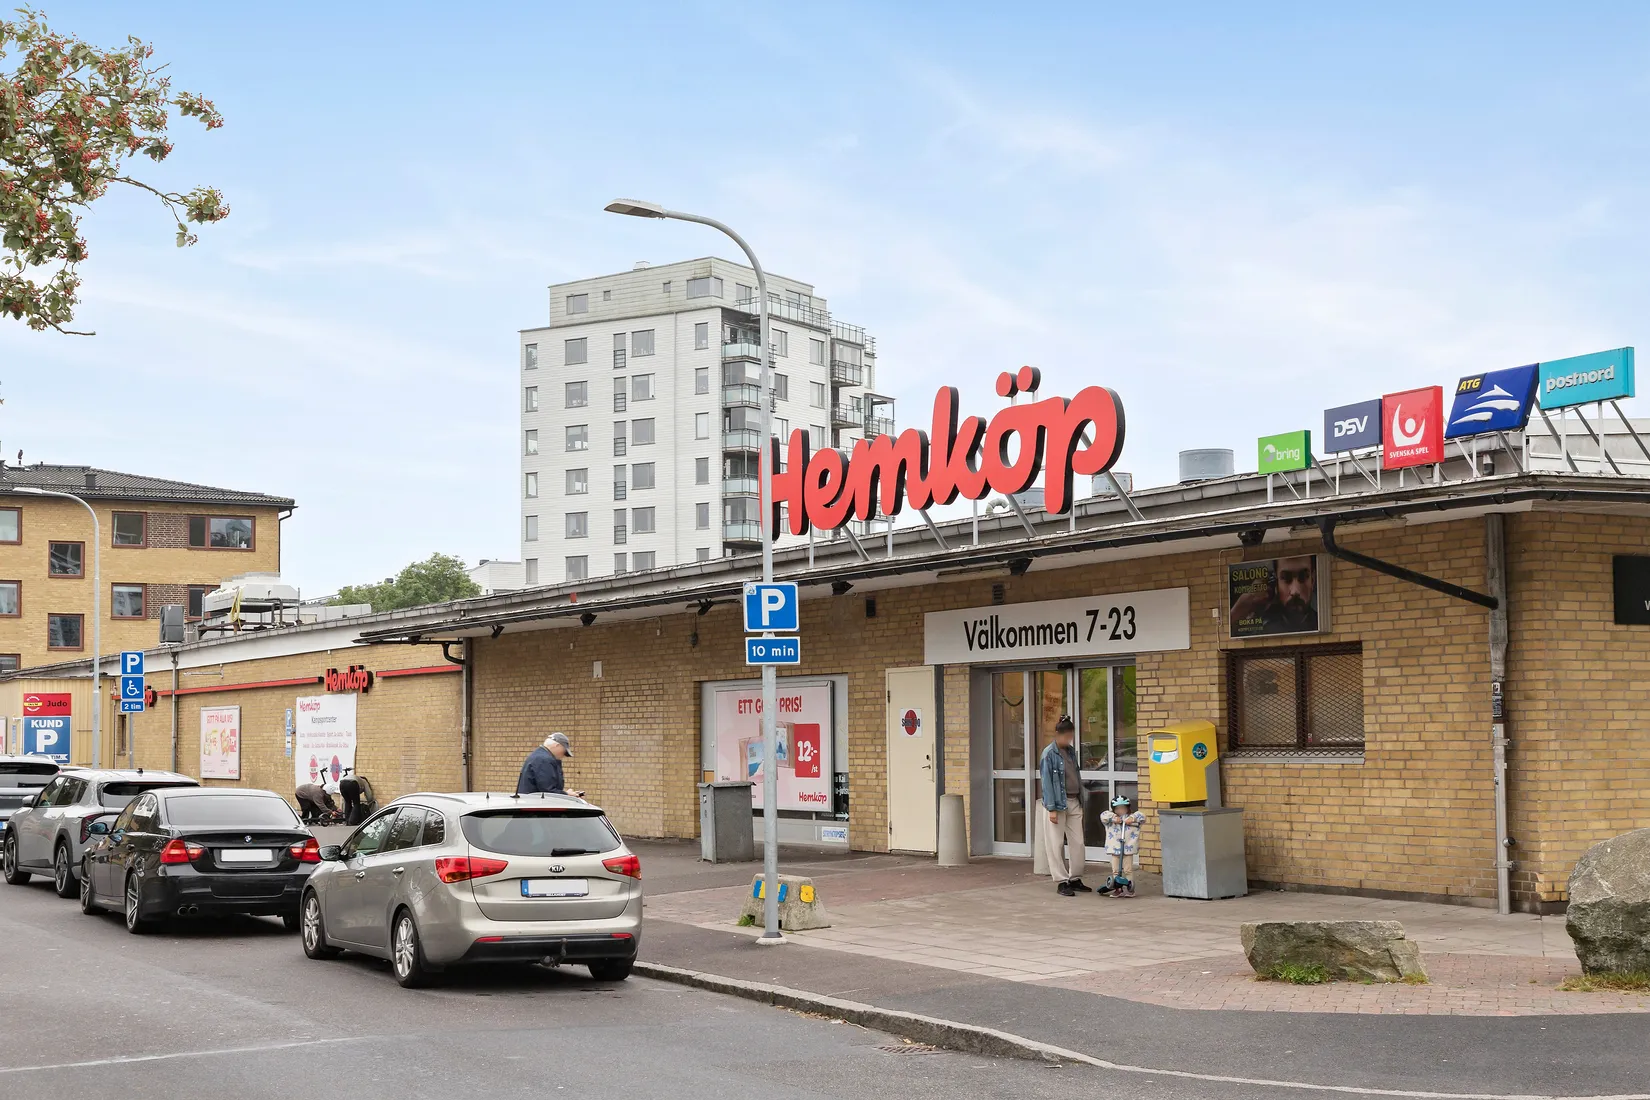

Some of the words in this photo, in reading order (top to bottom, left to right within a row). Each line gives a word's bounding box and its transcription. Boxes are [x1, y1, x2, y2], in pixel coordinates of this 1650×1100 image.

[1458, 378, 1481, 391] ATG
[1546, 365, 1614, 393] postnord
[1334, 415, 1368, 437] DSV
[760, 366, 1120, 540] Hemköp
[1276, 448, 1300, 460] bring
[1389, 449, 1414, 458] SVENSKA
[1415, 447, 1429, 455] SPEL
[1232, 567, 1268, 581] SALONG
[761, 588, 786, 626] P
[963, 614, 1078, 651] Välkommen
[1085, 605, 1137, 642] 7-23
[752, 645, 766, 657] 10
[771, 645, 794, 656] min
[126, 653, 140, 673] P
[325, 665, 369, 693] Hemköp
[299, 699, 320, 713] Hemköp
[738, 698, 753, 714] ETT
[779, 695, 802, 713] PRIS!
[31, 719, 64, 728] KUND
[36, 729, 59, 753] P
[799, 791, 828, 804] Hemköp
